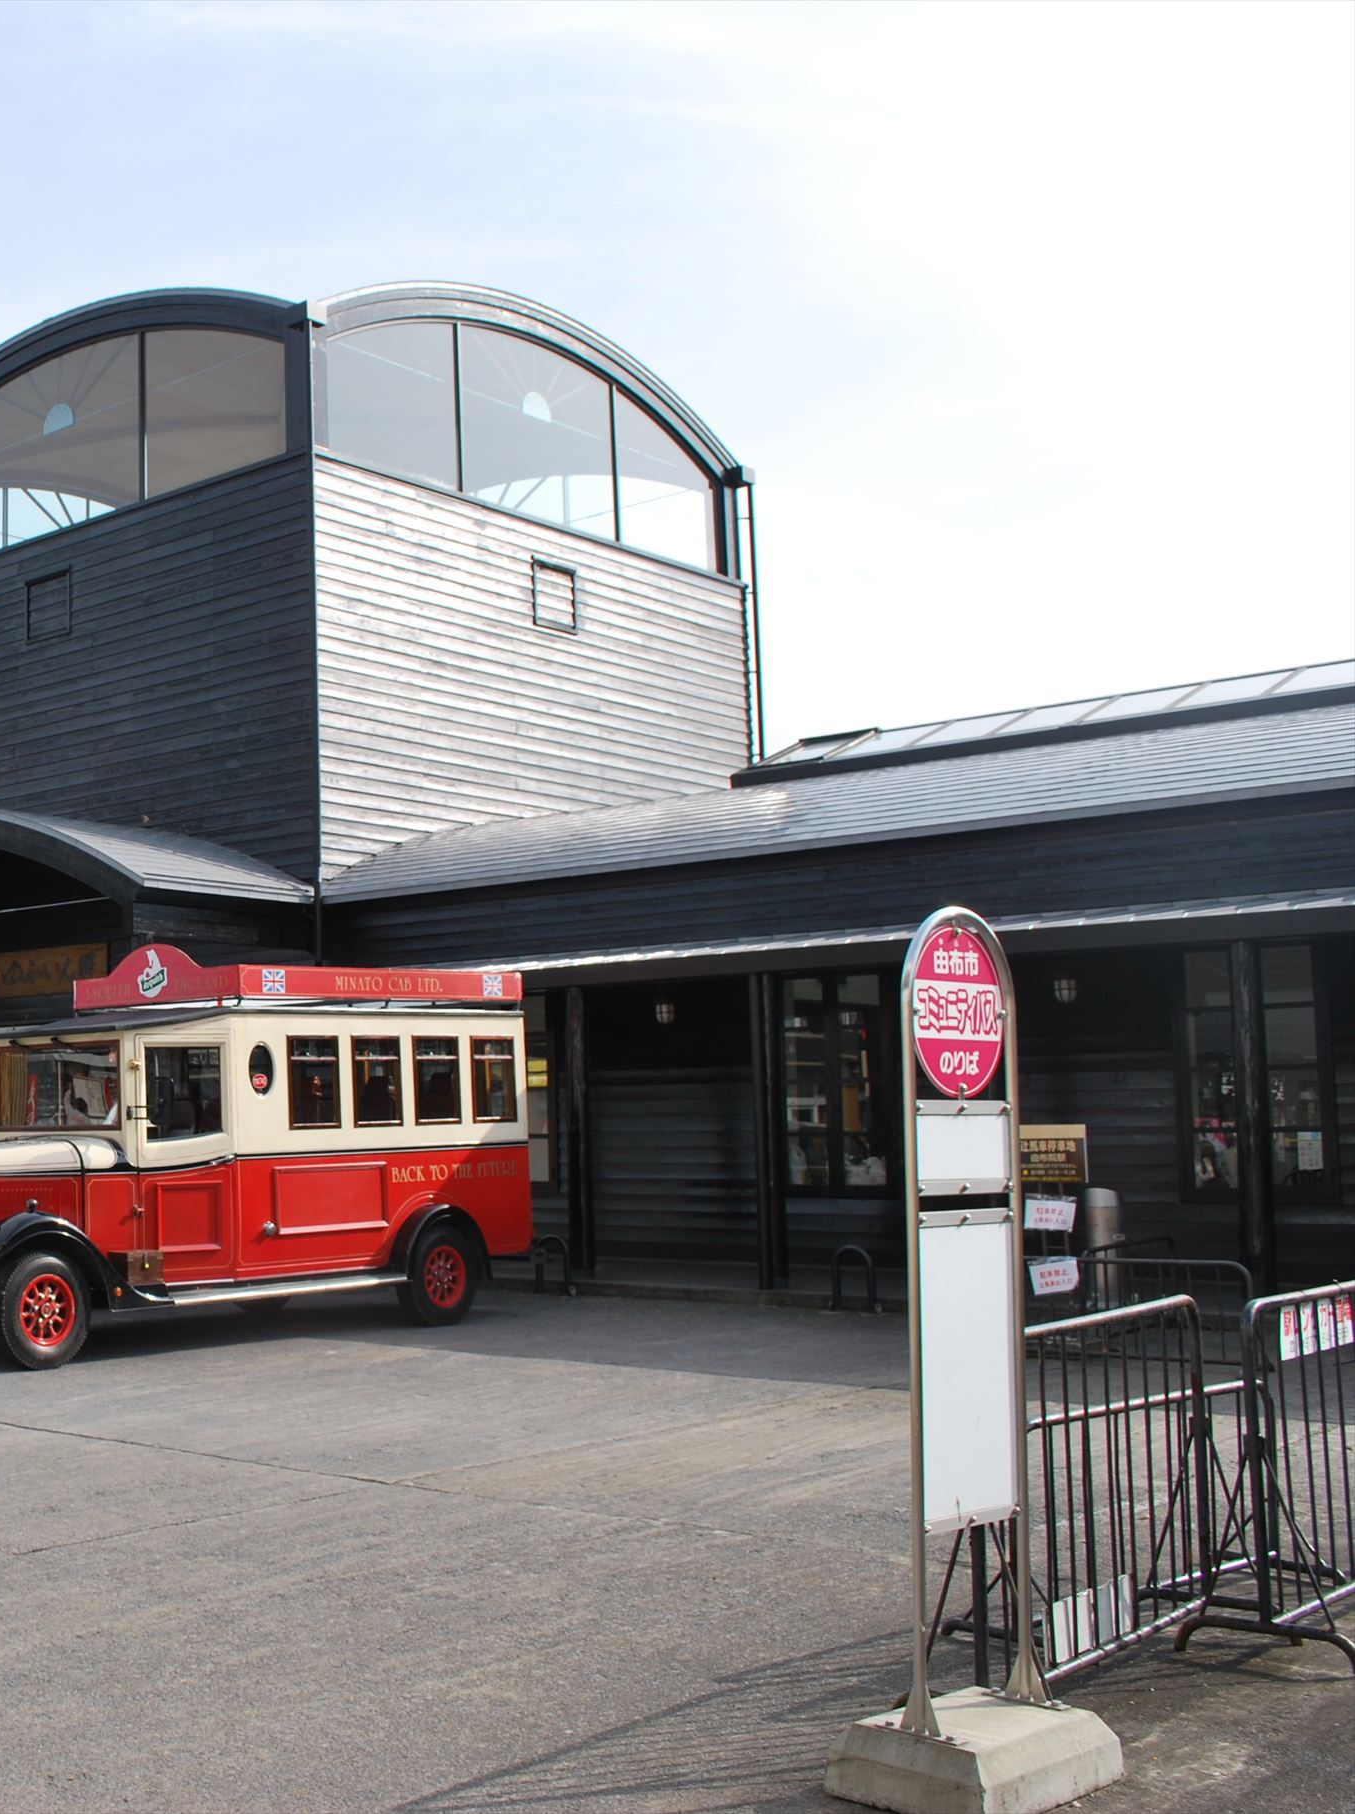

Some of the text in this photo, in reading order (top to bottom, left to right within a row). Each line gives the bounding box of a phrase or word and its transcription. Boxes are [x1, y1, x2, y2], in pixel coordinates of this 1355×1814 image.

[933, 947, 979, 976] 由布市
[335, 976, 443, 992] MINATO CAB LTD.
[917, 986, 998, 1035] コミュニティバス
[939, 1050, 980, 1076] のりば
[391, 1160, 518, 1182] BACK TO THE FUTURE
